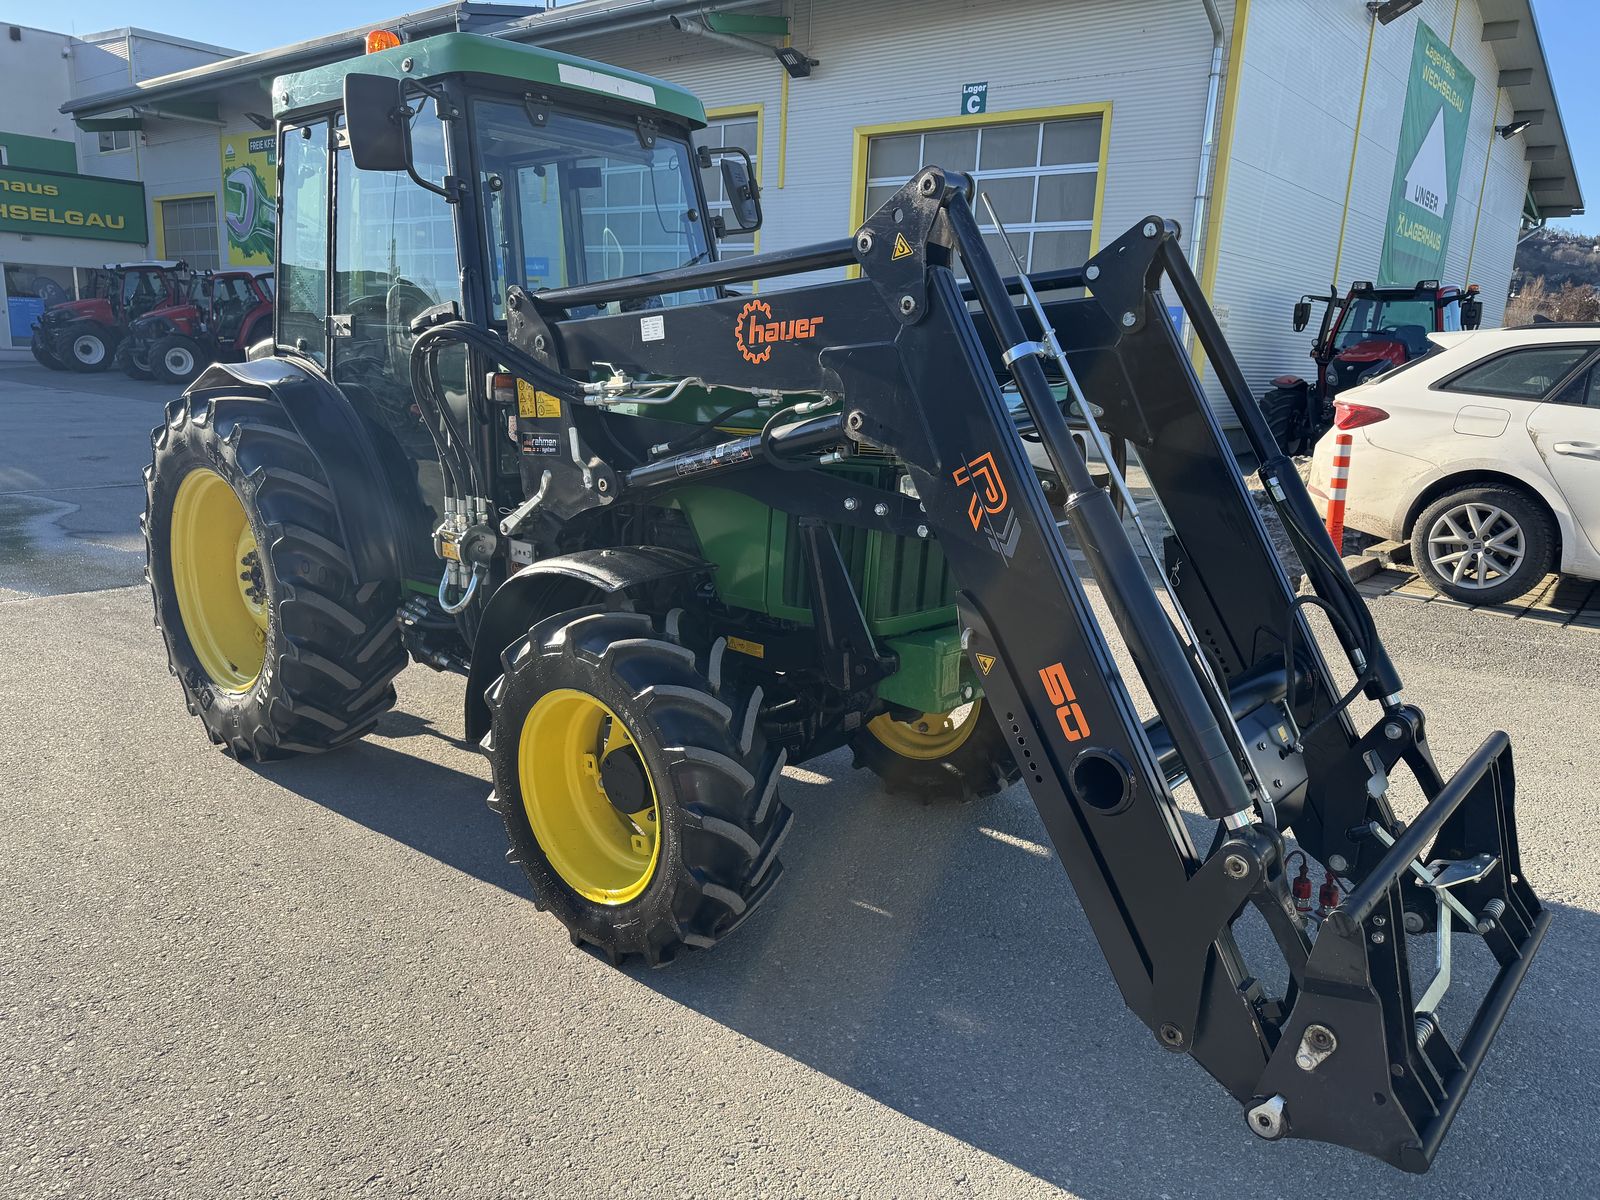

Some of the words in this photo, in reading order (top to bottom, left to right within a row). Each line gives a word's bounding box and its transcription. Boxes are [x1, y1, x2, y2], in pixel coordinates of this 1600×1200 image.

[1425, 42, 1456, 80] Lagerhaus
[963, 84, 987, 94] Lager
[1422, 63, 1465, 113] WECHSELGAU
[967, 95, 981, 114] C
[1414, 184, 1439, 213] UNSER
[1403, 218, 1441, 251] LAGERHAUS
[748, 315, 824, 345] hauer
[1038, 662, 1091, 742] 50
